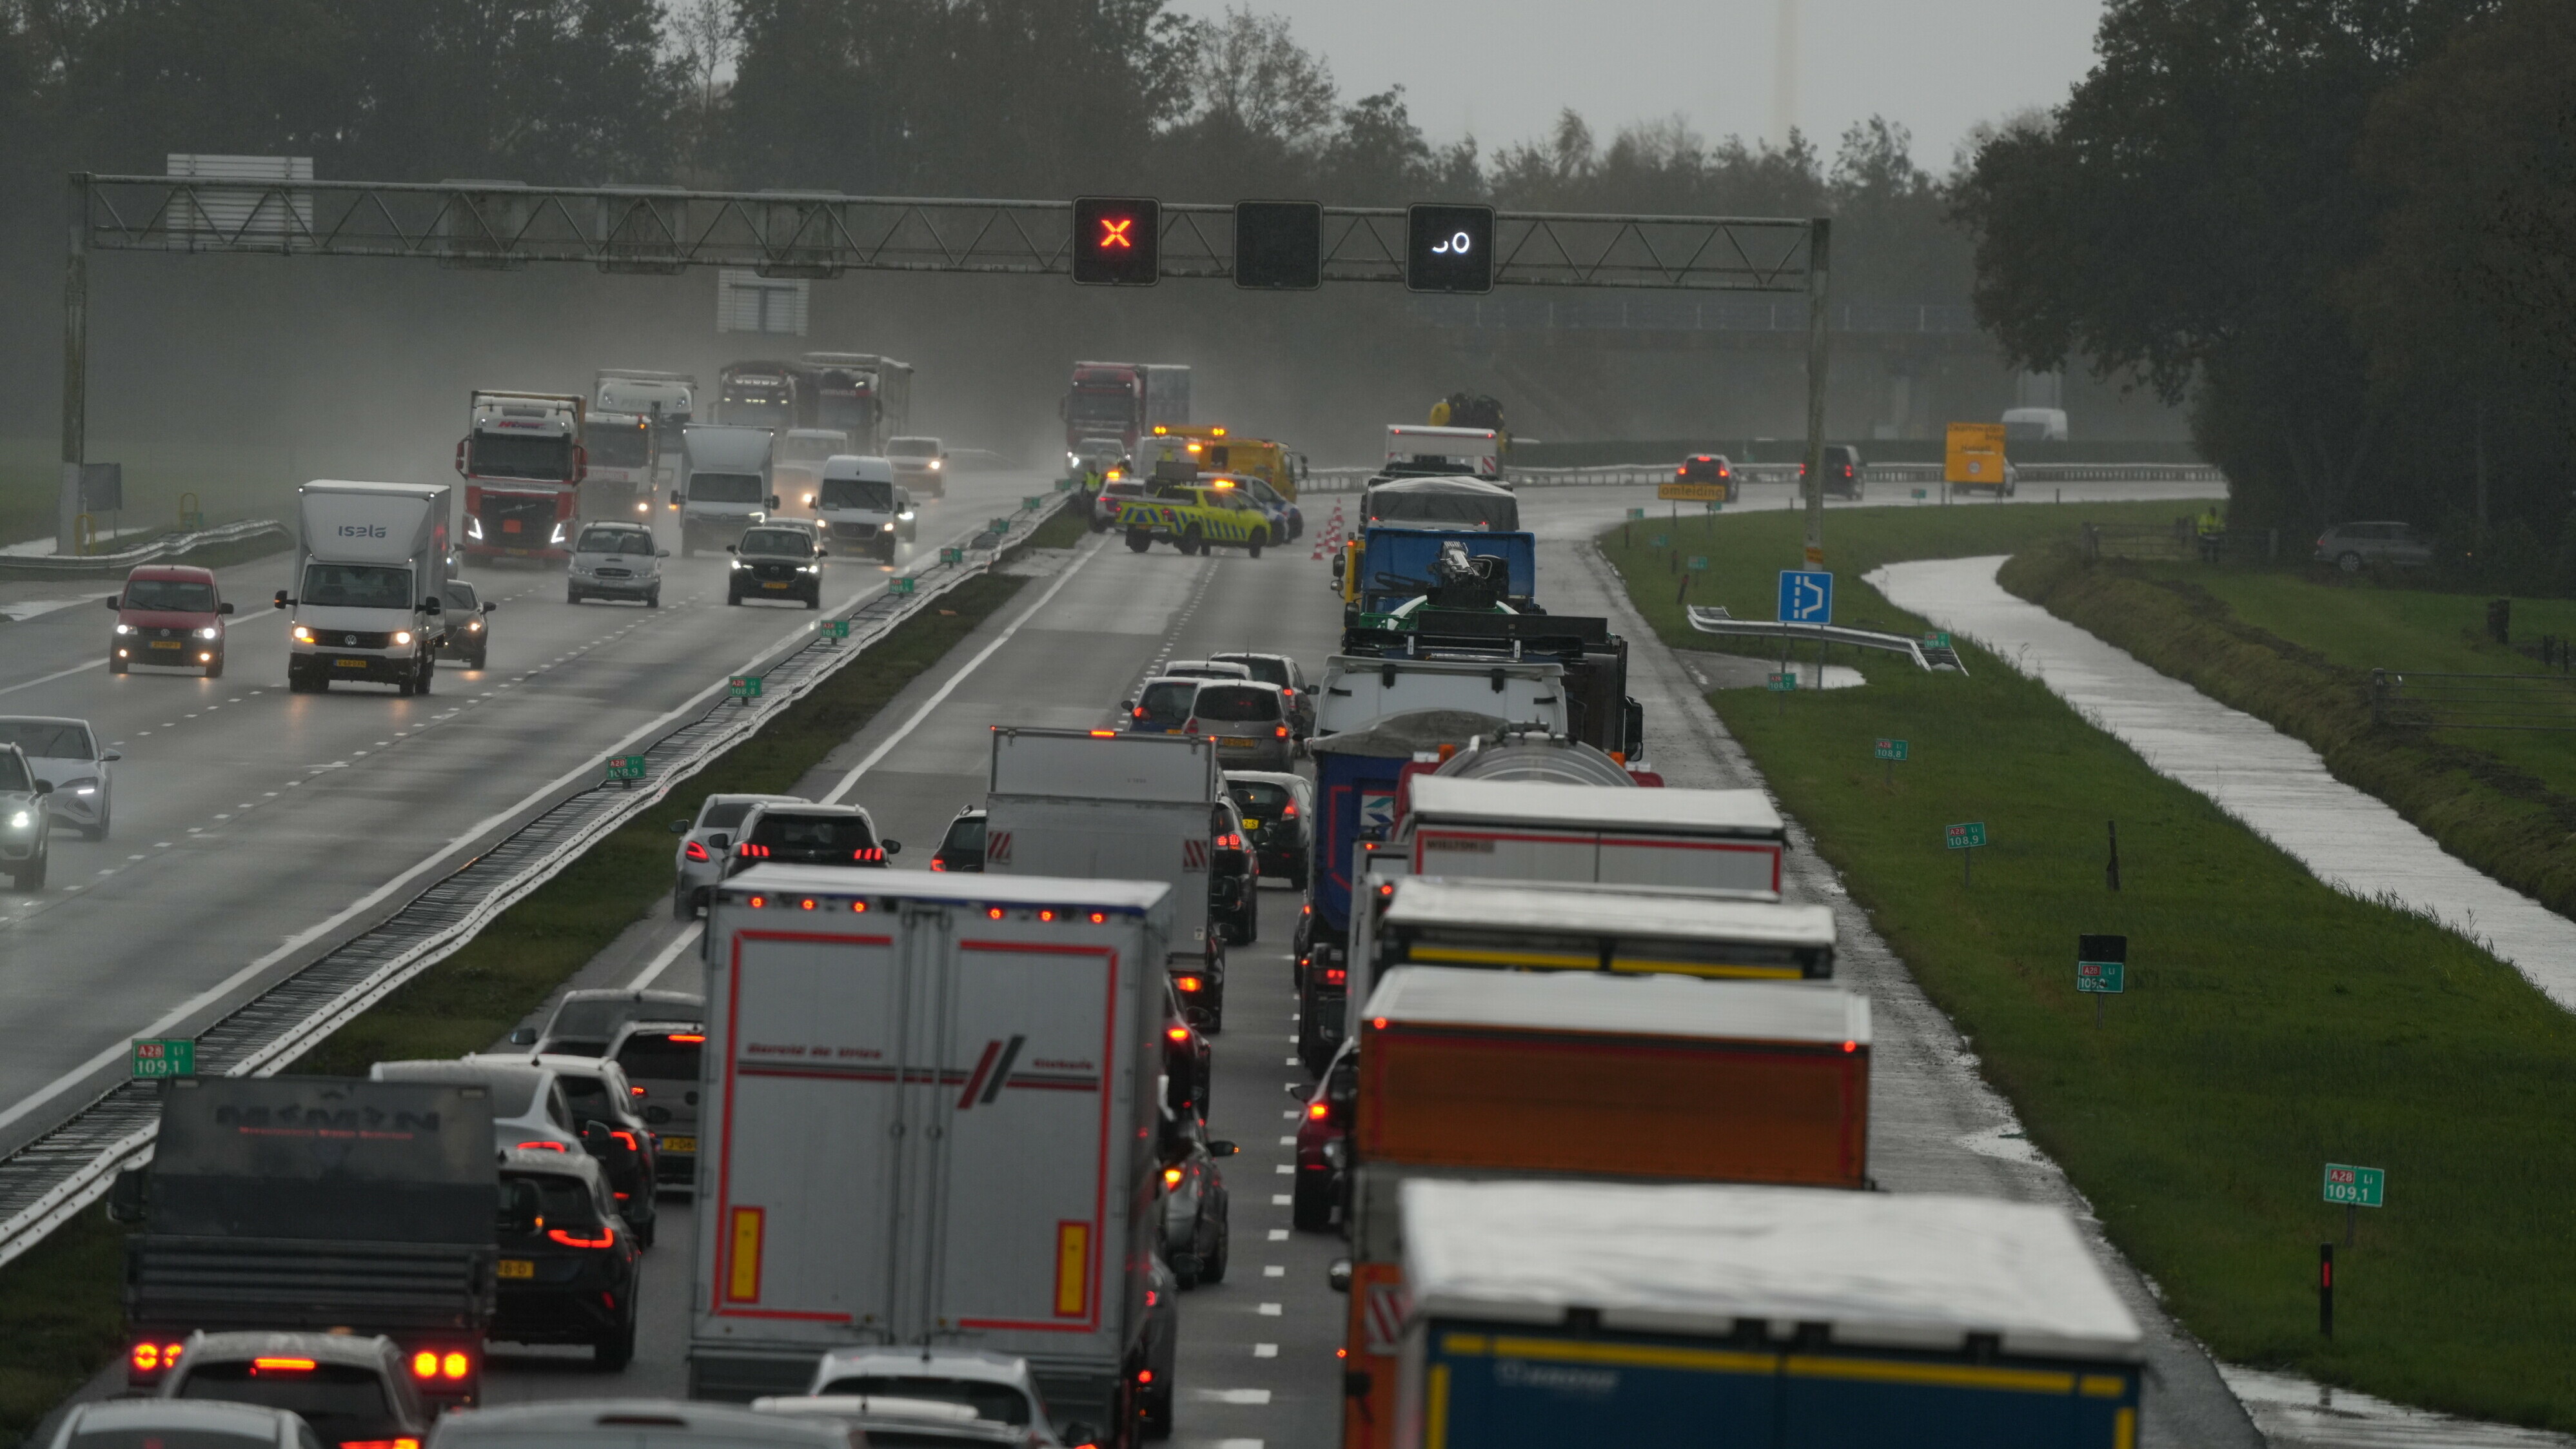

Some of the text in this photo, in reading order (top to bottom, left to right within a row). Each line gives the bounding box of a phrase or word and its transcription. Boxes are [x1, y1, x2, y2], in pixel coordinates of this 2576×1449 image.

[1662, 485, 1723, 498] omleiding
[139, 1045, 162, 1056] A28
[2331, 1170, 2353, 1182] A28
